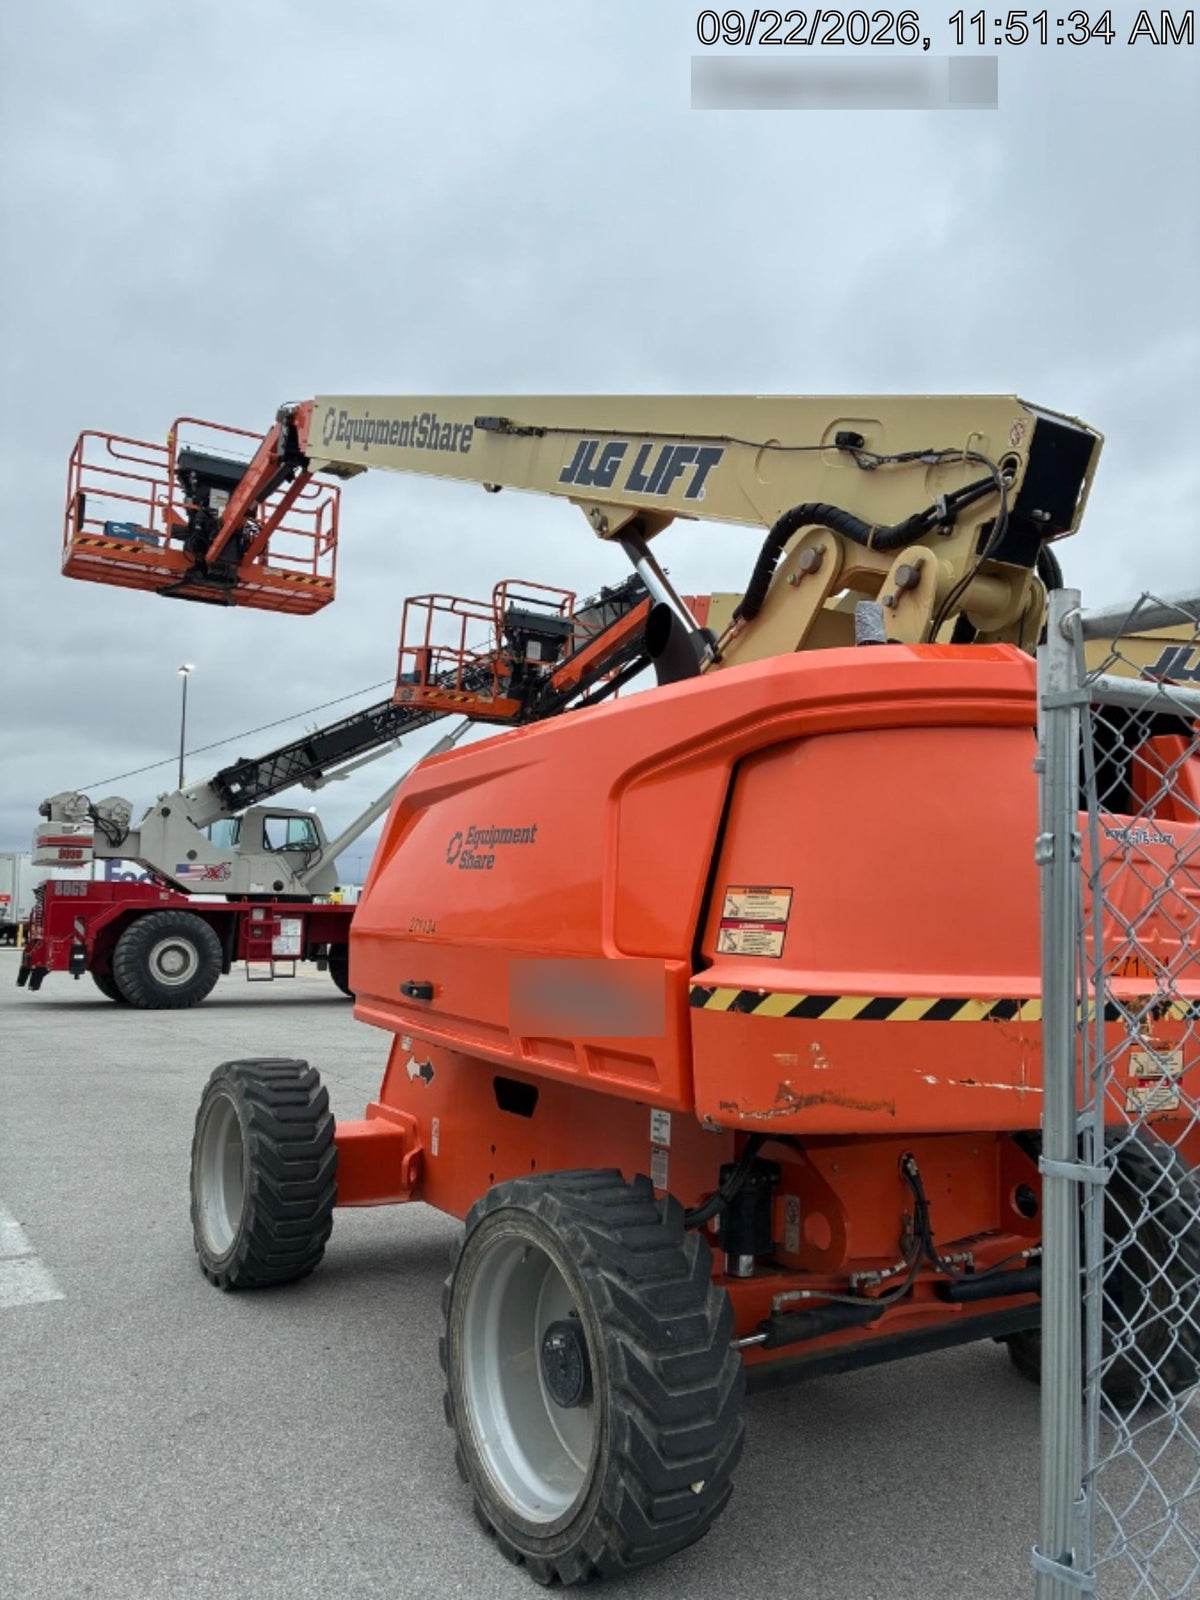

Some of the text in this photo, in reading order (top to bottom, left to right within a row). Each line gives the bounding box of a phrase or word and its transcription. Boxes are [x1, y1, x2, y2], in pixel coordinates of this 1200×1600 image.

[336, 410, 474, 454] EquipmentShare
[557, 439, 726, 500] JLG LIFT
[1139, 645, 1200, 683] JL
[465, 824, 538, 849] Equipment
[459, 849, 495, 870] Share
